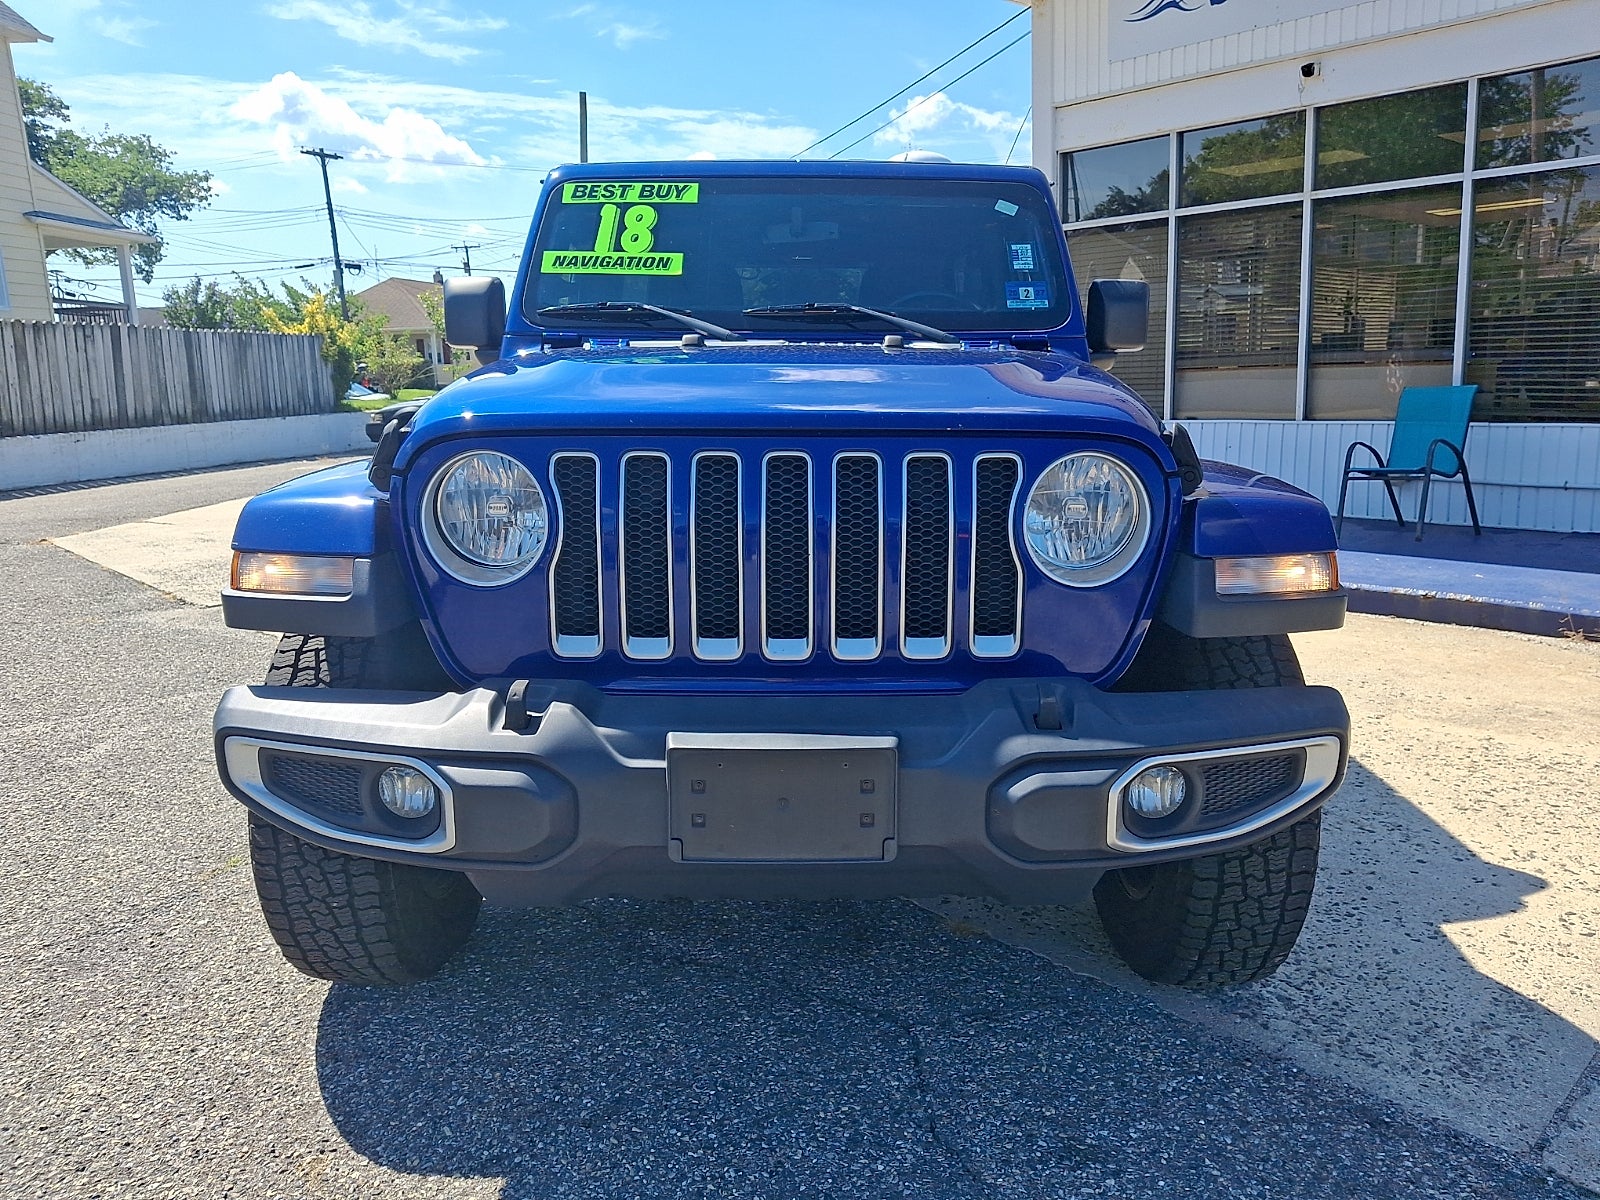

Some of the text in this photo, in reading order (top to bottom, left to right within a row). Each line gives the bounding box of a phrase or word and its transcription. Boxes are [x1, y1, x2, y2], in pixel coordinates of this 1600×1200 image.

[570, 184, 692, 200] BEST BUY
[594, 203, 658, 253] 18
[552, 255, 673, 271] NAVIGATION
[1024, 288, 1030, 298] 2
